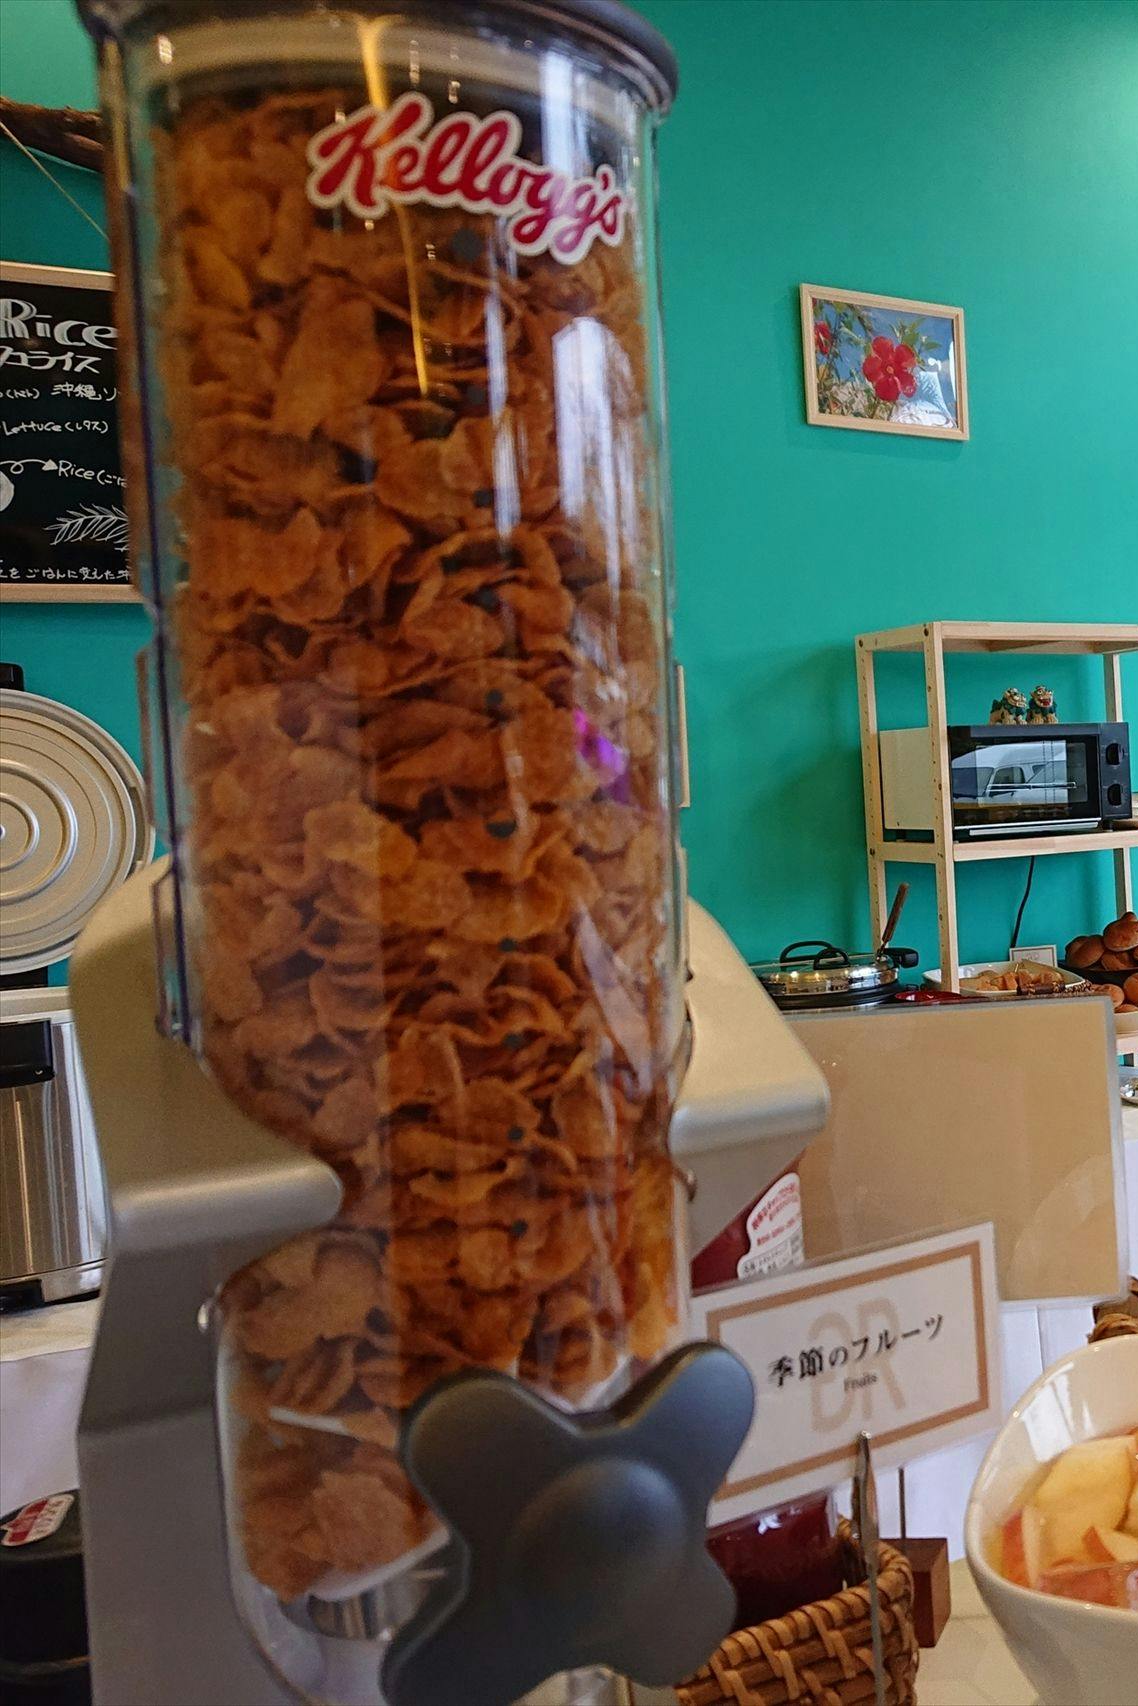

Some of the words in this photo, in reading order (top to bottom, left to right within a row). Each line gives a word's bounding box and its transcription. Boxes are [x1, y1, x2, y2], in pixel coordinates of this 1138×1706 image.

[308, 93, 623, 262] Kellogg's
[0, 298, 119, 351] Rice
[767, 1313, 944, 1388] 季節のフルーツ
